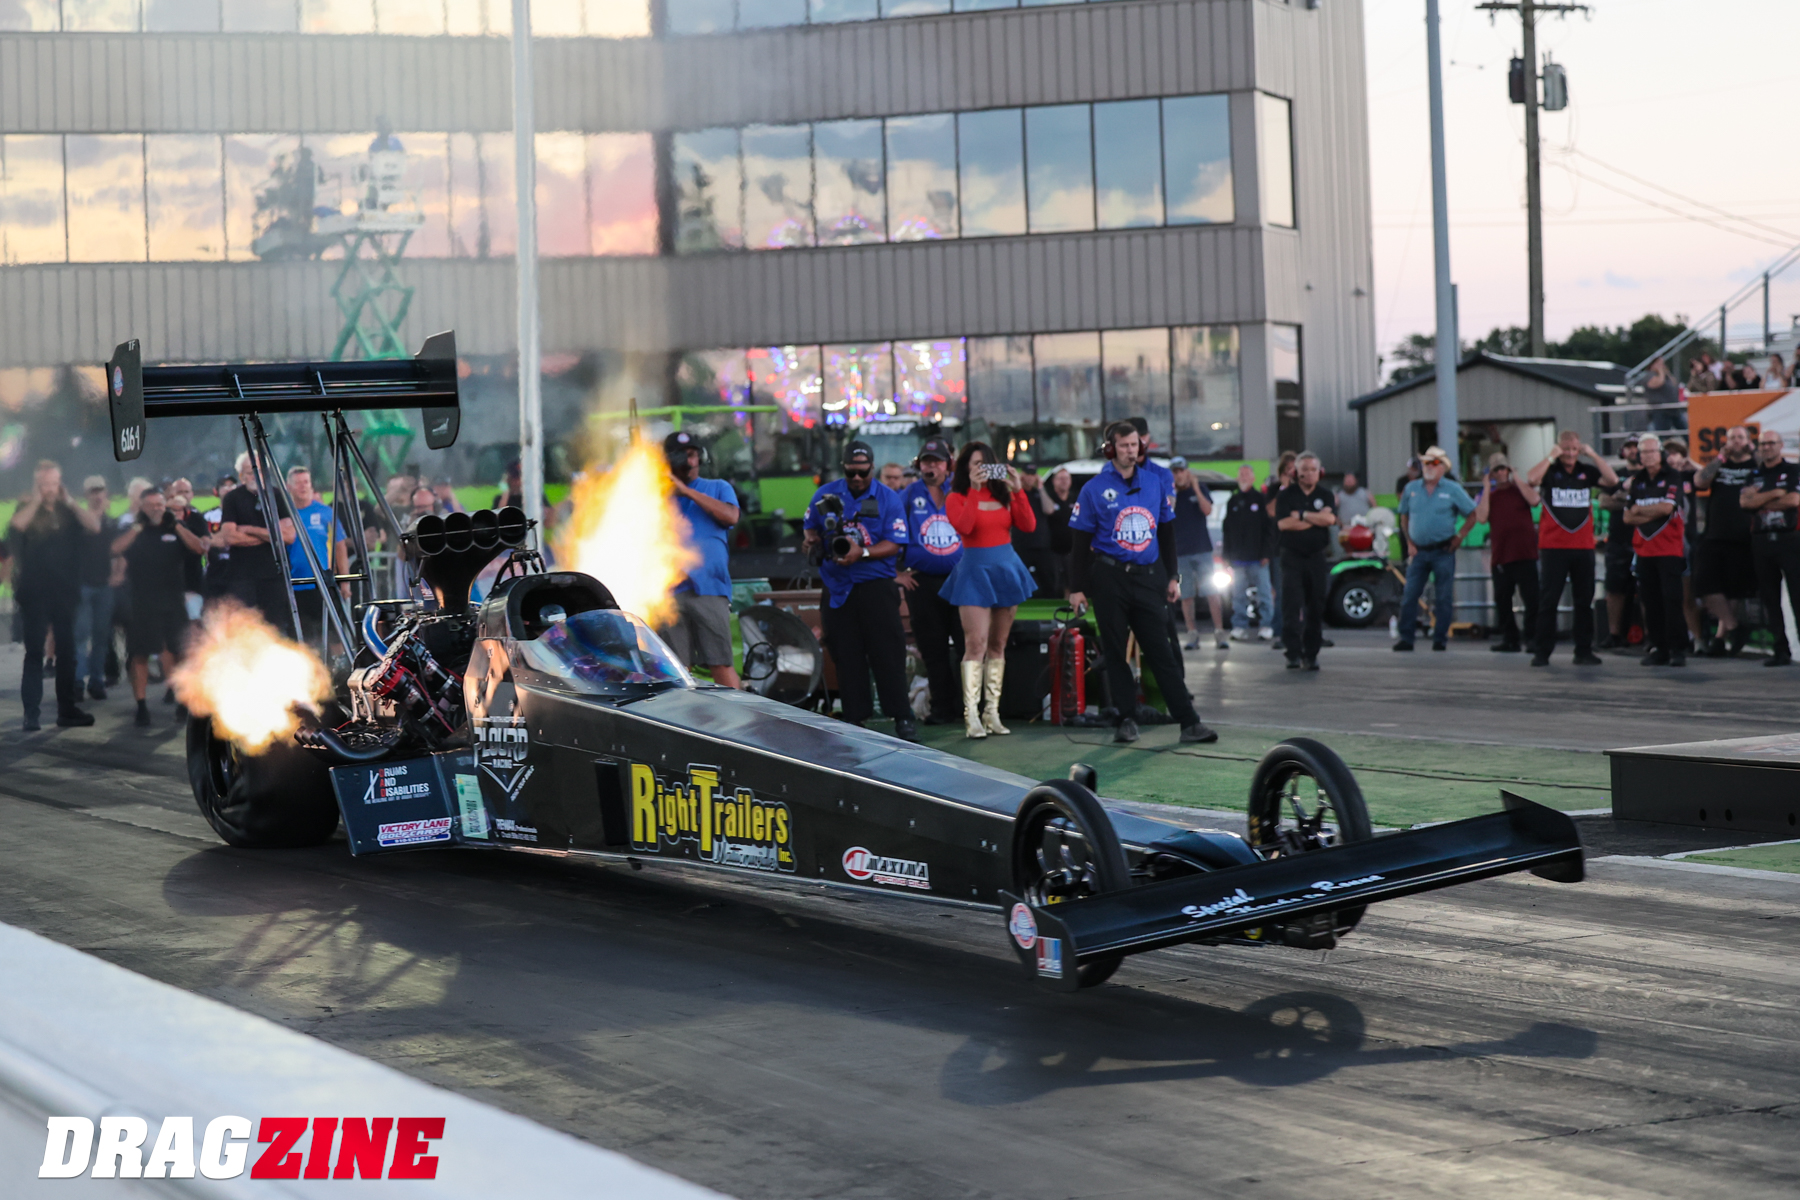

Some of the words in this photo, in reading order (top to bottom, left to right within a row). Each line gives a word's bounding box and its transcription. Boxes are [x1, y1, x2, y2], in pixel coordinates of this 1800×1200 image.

[128, 340, 136, 351] TF
[859, 422, 916, 436] FENDT
[923, 535, 959, 545] IHRA
[1117, 530, 1153, 540] IHRA
[473, 727, 529, 768] PLOURD
[492, 758, 513, 769] RACING
[379, 765, 408, 778] DRUMS
[380, 777, 397, 787] AND
[380, 782, 430, 798] DISABILITIES
[381, 821, 422, 833] VICTORY
[423, 819, 450, 829] LANE
[381, 831, 409, 840] GOLF
[866, 857, 928, 879] MAXIMA
[873, 874, 908, 885] RACING
[907, 879, 931, 890] OILS
[1181, 888, 1256, 918] Special
[1224, 898, 1303, 914] Thanks
